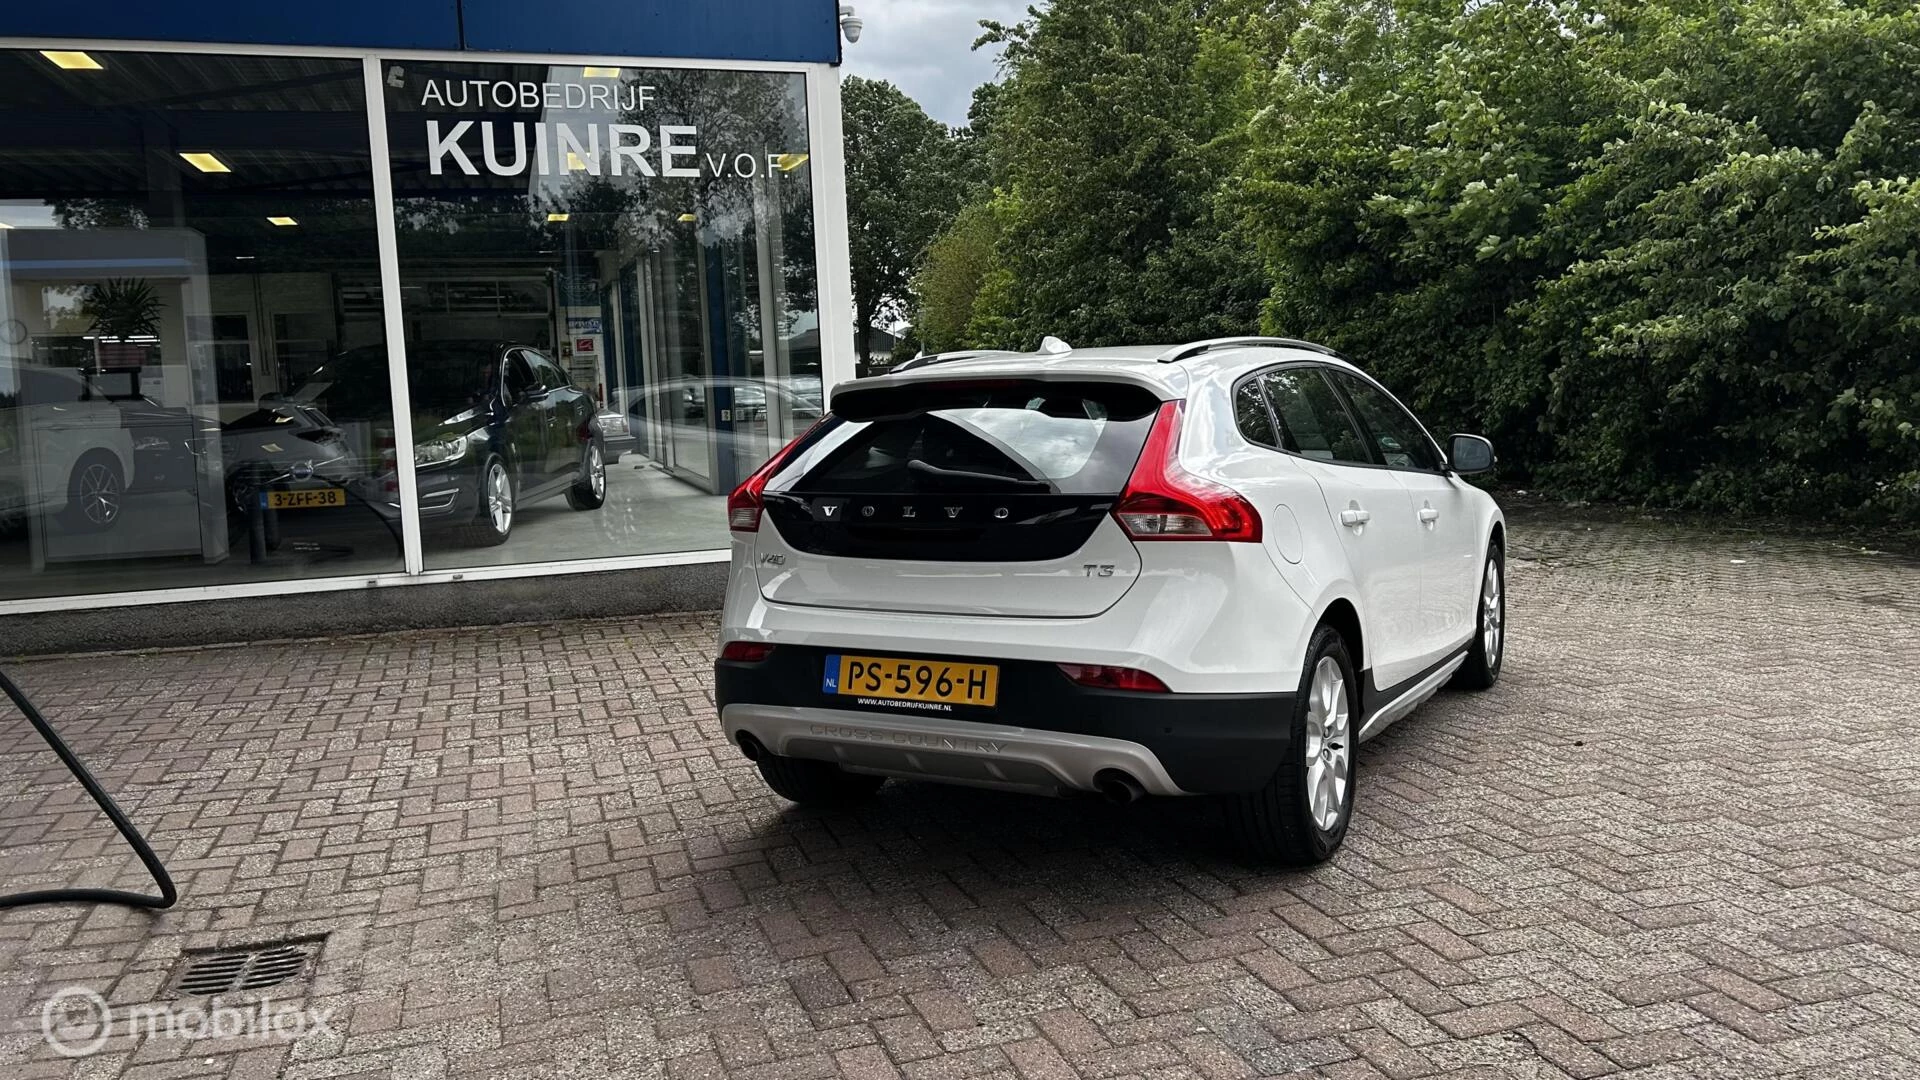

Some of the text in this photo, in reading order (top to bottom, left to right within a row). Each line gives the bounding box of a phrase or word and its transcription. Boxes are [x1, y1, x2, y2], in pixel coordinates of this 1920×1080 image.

[421, 79, 656, 112] AUTOBEDRIJF
[426, 119, 701, 177] KUINRE
[273, 491, 337, 507] 3-ZFF-38
[822, 505, 1010, 519] VOLVO
[1083, 564, 1115, 577] T3
[825, 678, 837, 688] NL
[847, 661, 987, 700] PS-596-H
[857, 698, 953, 712] WWW.AUTOBEDRIJFKUINRE.NL
[810, 724, 1008, 753] CROSS COUNTRY
